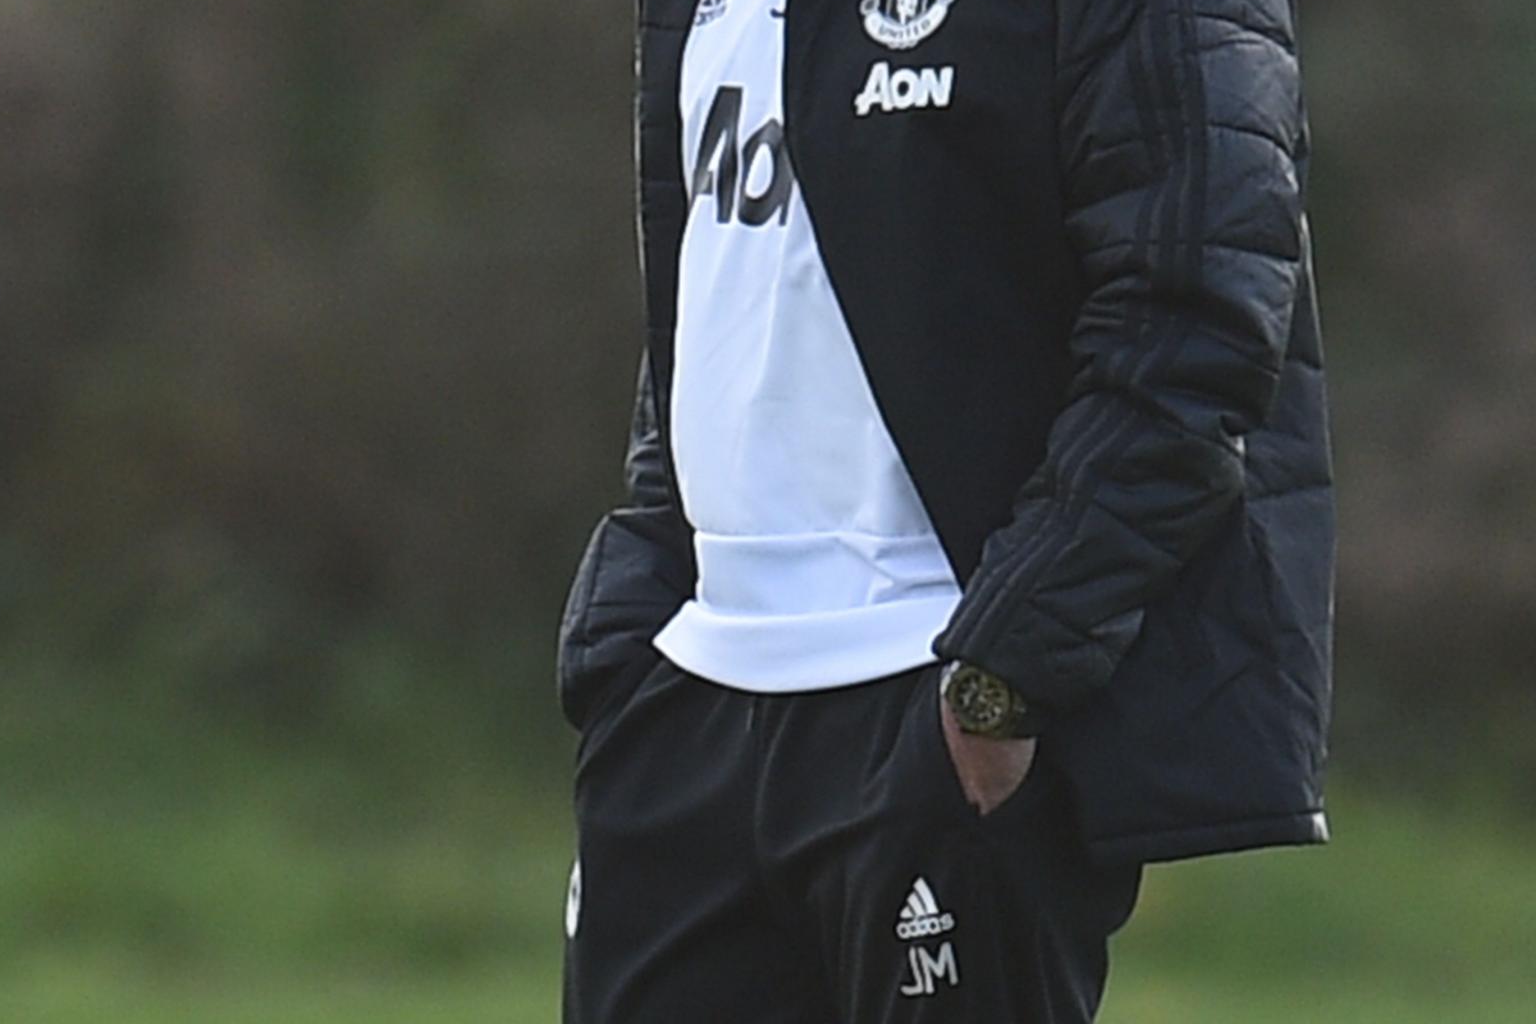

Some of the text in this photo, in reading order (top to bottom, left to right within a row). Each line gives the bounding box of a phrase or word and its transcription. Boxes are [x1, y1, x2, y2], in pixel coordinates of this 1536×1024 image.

[855, 62, 953, 115] AON
[896, 913, 954, 939] adidas
[901, 941, 958, 995] JM
